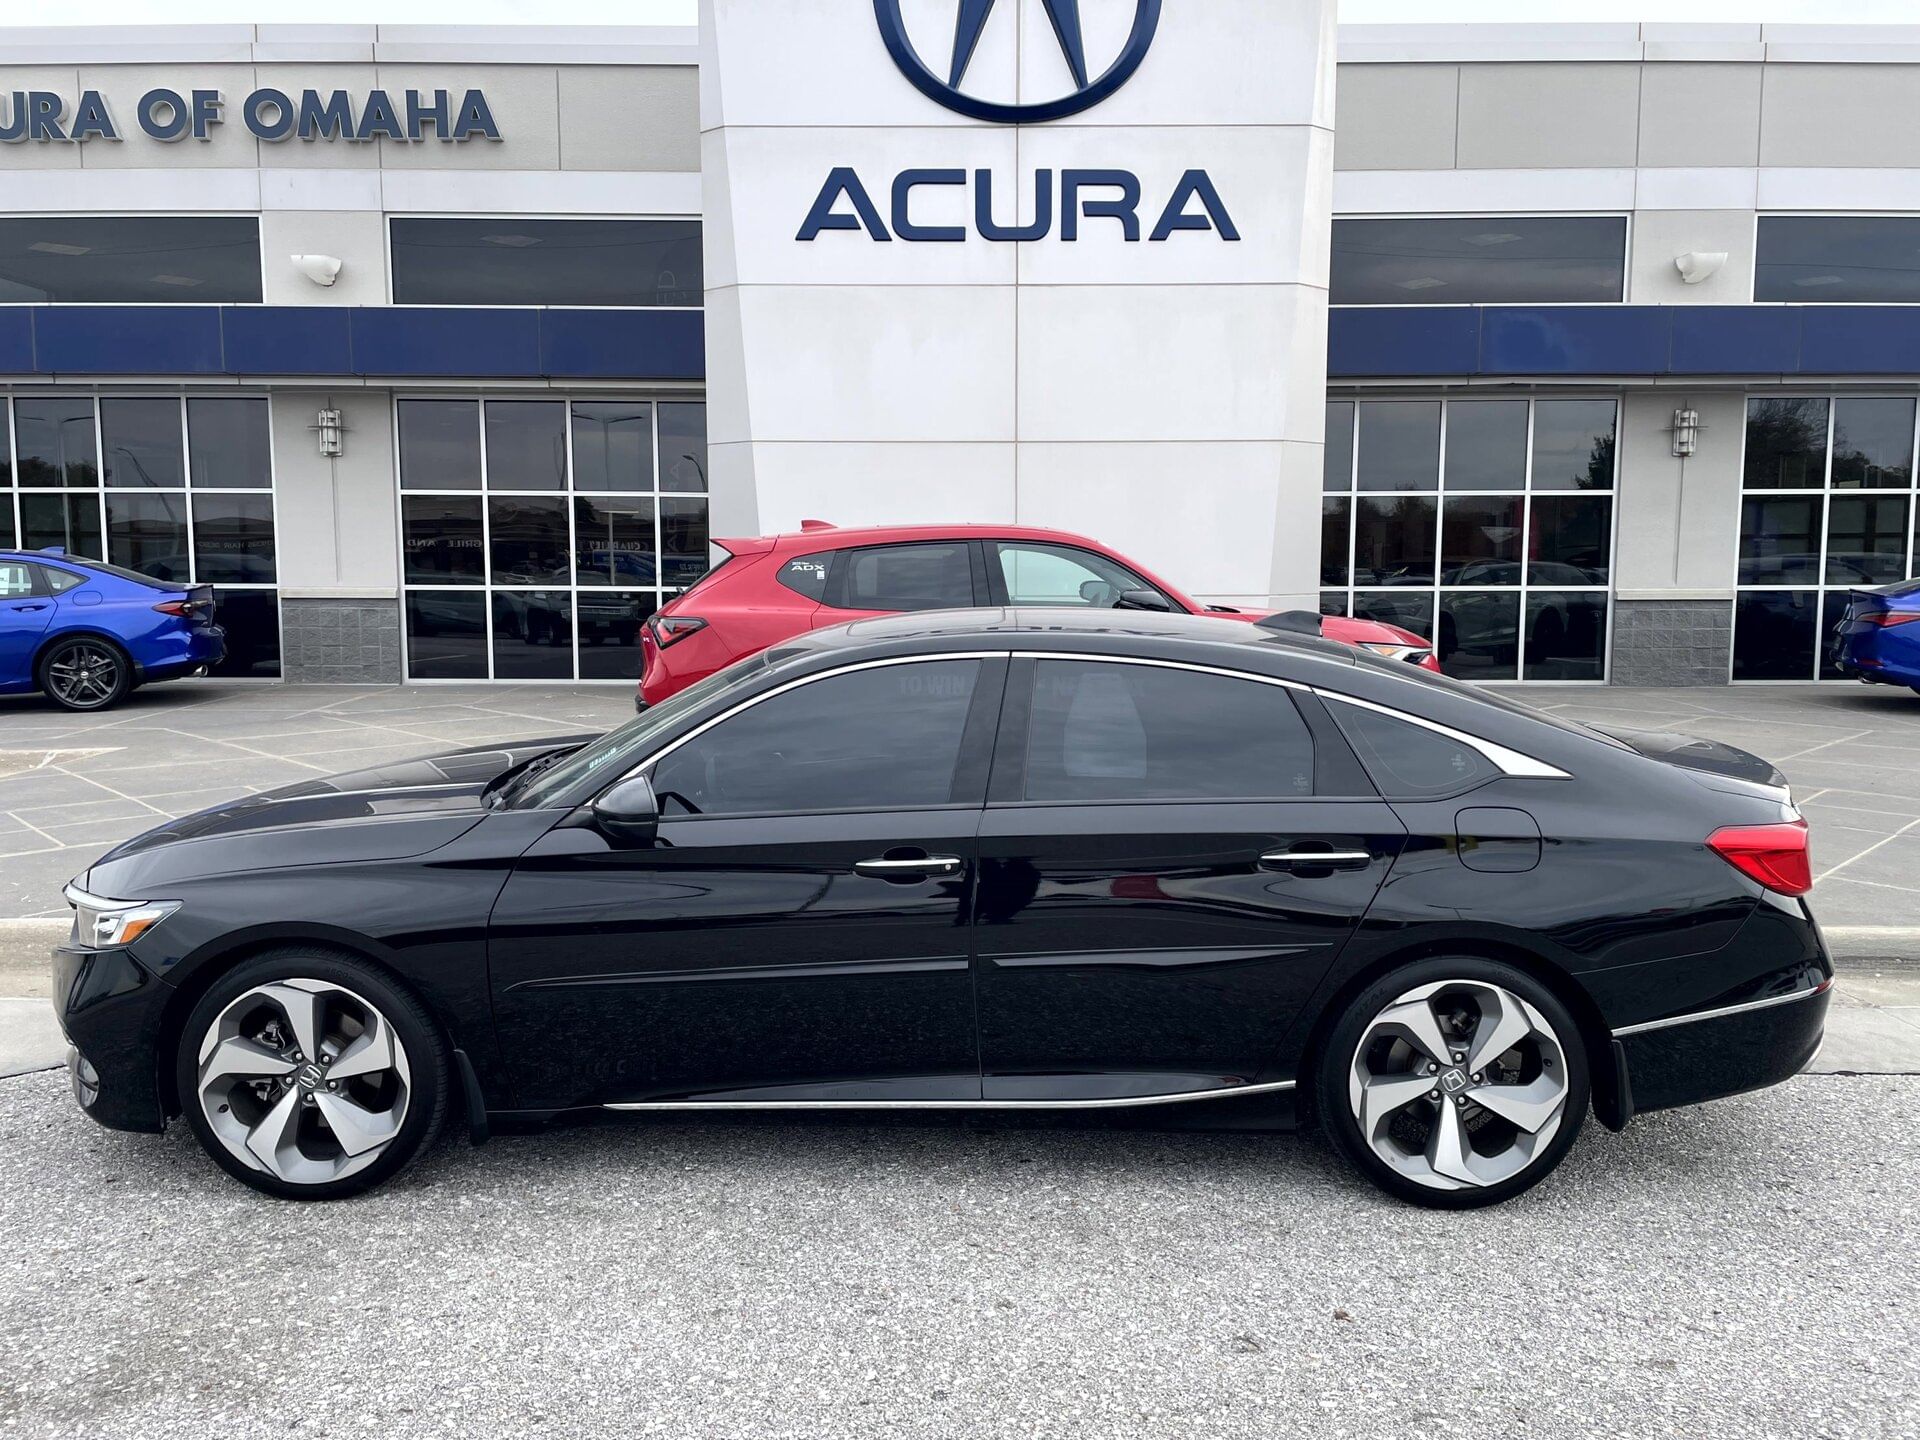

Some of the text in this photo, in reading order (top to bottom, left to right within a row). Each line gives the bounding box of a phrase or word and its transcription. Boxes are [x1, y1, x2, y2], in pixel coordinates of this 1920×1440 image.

[137, 88, 224, 143] OF
[243, 88, 504, 143] OMAHA
[795, 167, 1241, 241] ACURA
